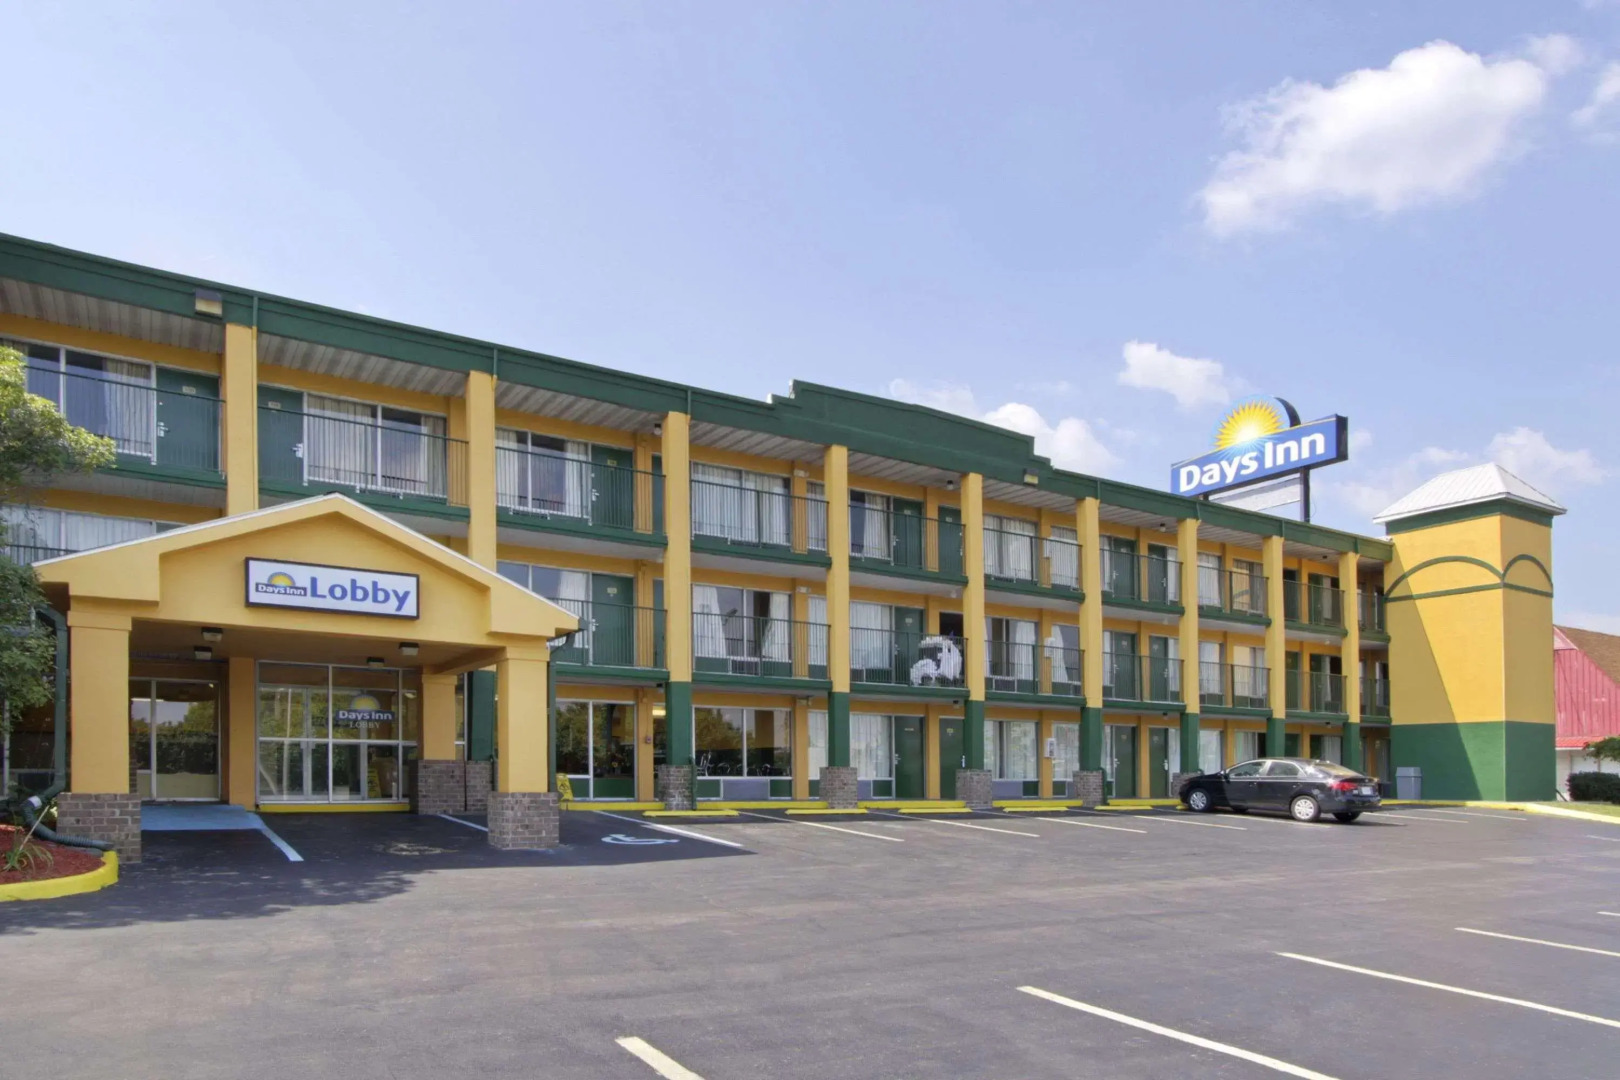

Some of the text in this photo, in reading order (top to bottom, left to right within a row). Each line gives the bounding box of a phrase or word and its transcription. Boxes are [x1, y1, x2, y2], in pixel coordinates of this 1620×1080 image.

[1179, 433, 1325, 493] Days Inn
[258, 584, 305, 595] Days Inn
[310, 576, 411, 612] Lobby
[338, 710, 393, 720] Days Inn
[350, 721, 380, 729] LOBBY
